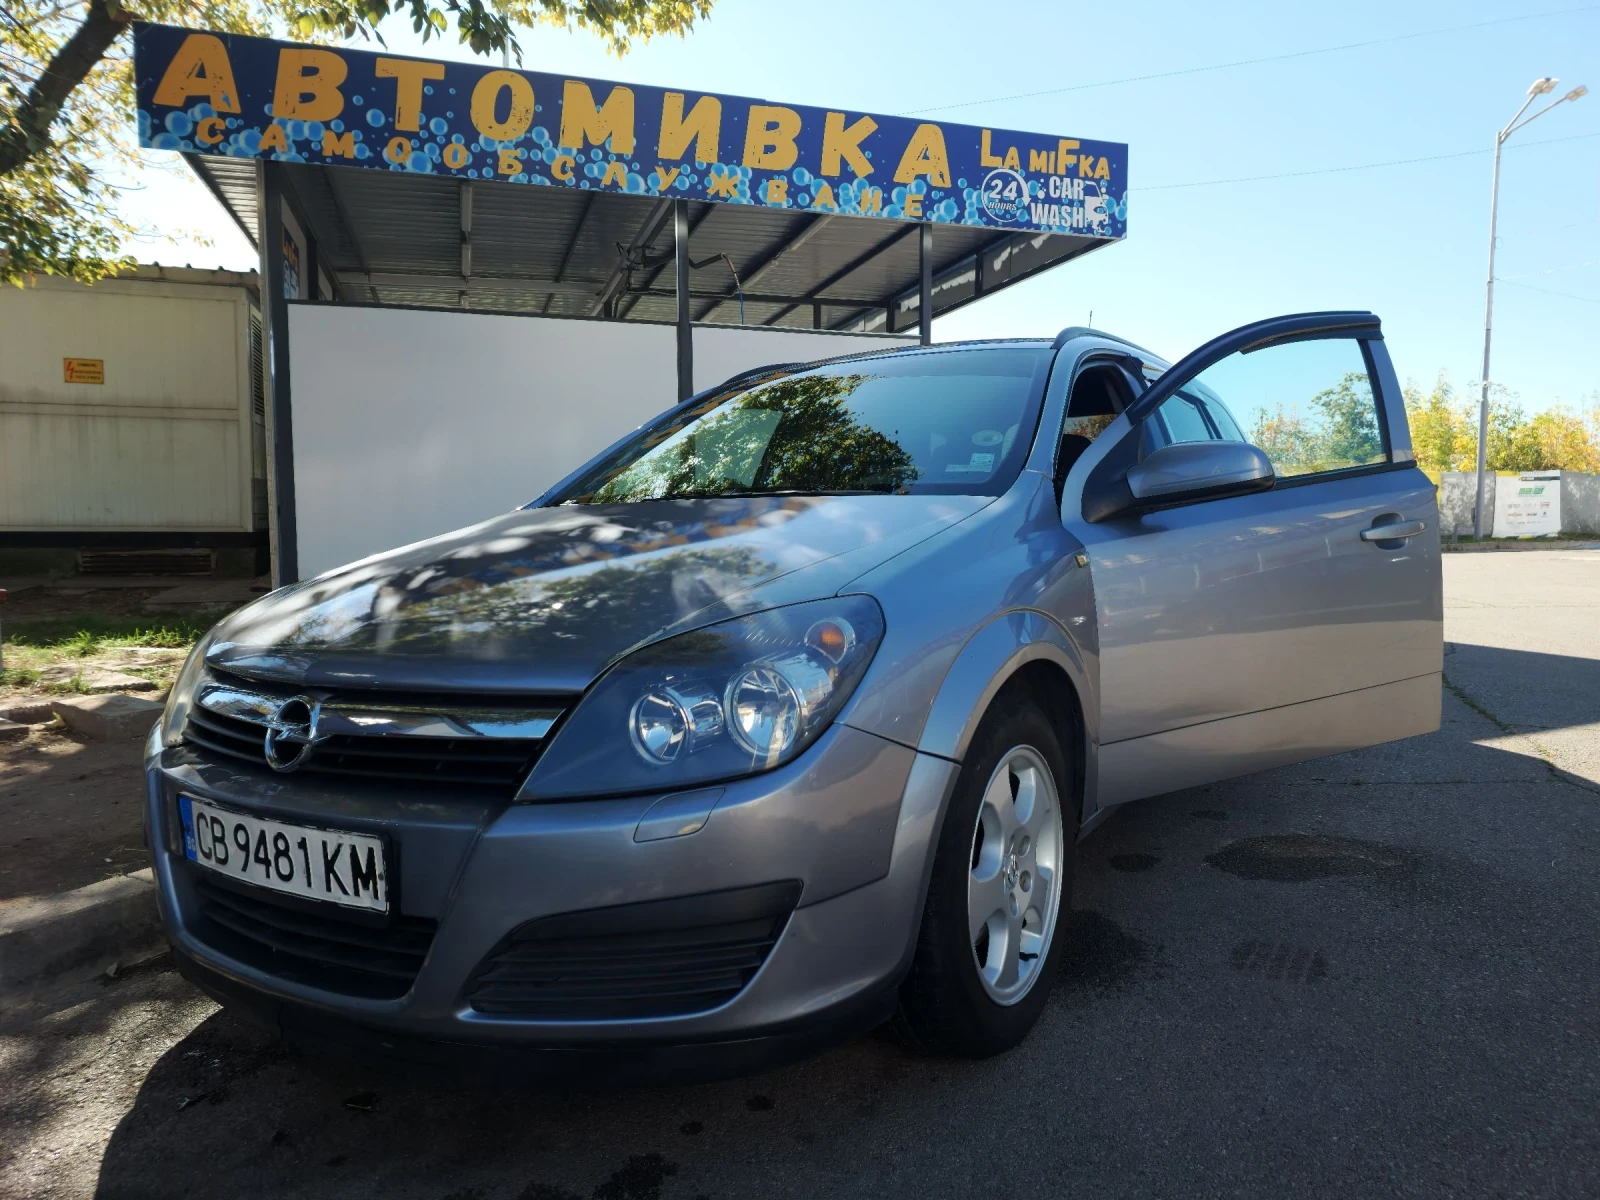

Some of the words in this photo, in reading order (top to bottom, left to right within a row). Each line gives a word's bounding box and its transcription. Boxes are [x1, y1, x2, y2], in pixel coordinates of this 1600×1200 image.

[152, 33, 952, 188] АВТОМИВКА
[195, 117, 924, 217] САМООБСЛУЖВАНЕ
[988, 179, 1018, 201] 24
[1049, 176, 1084, 200] CAR
[988, 201, 1018, 211] HOURS
[1030, 202, 1084, 228] WASH
